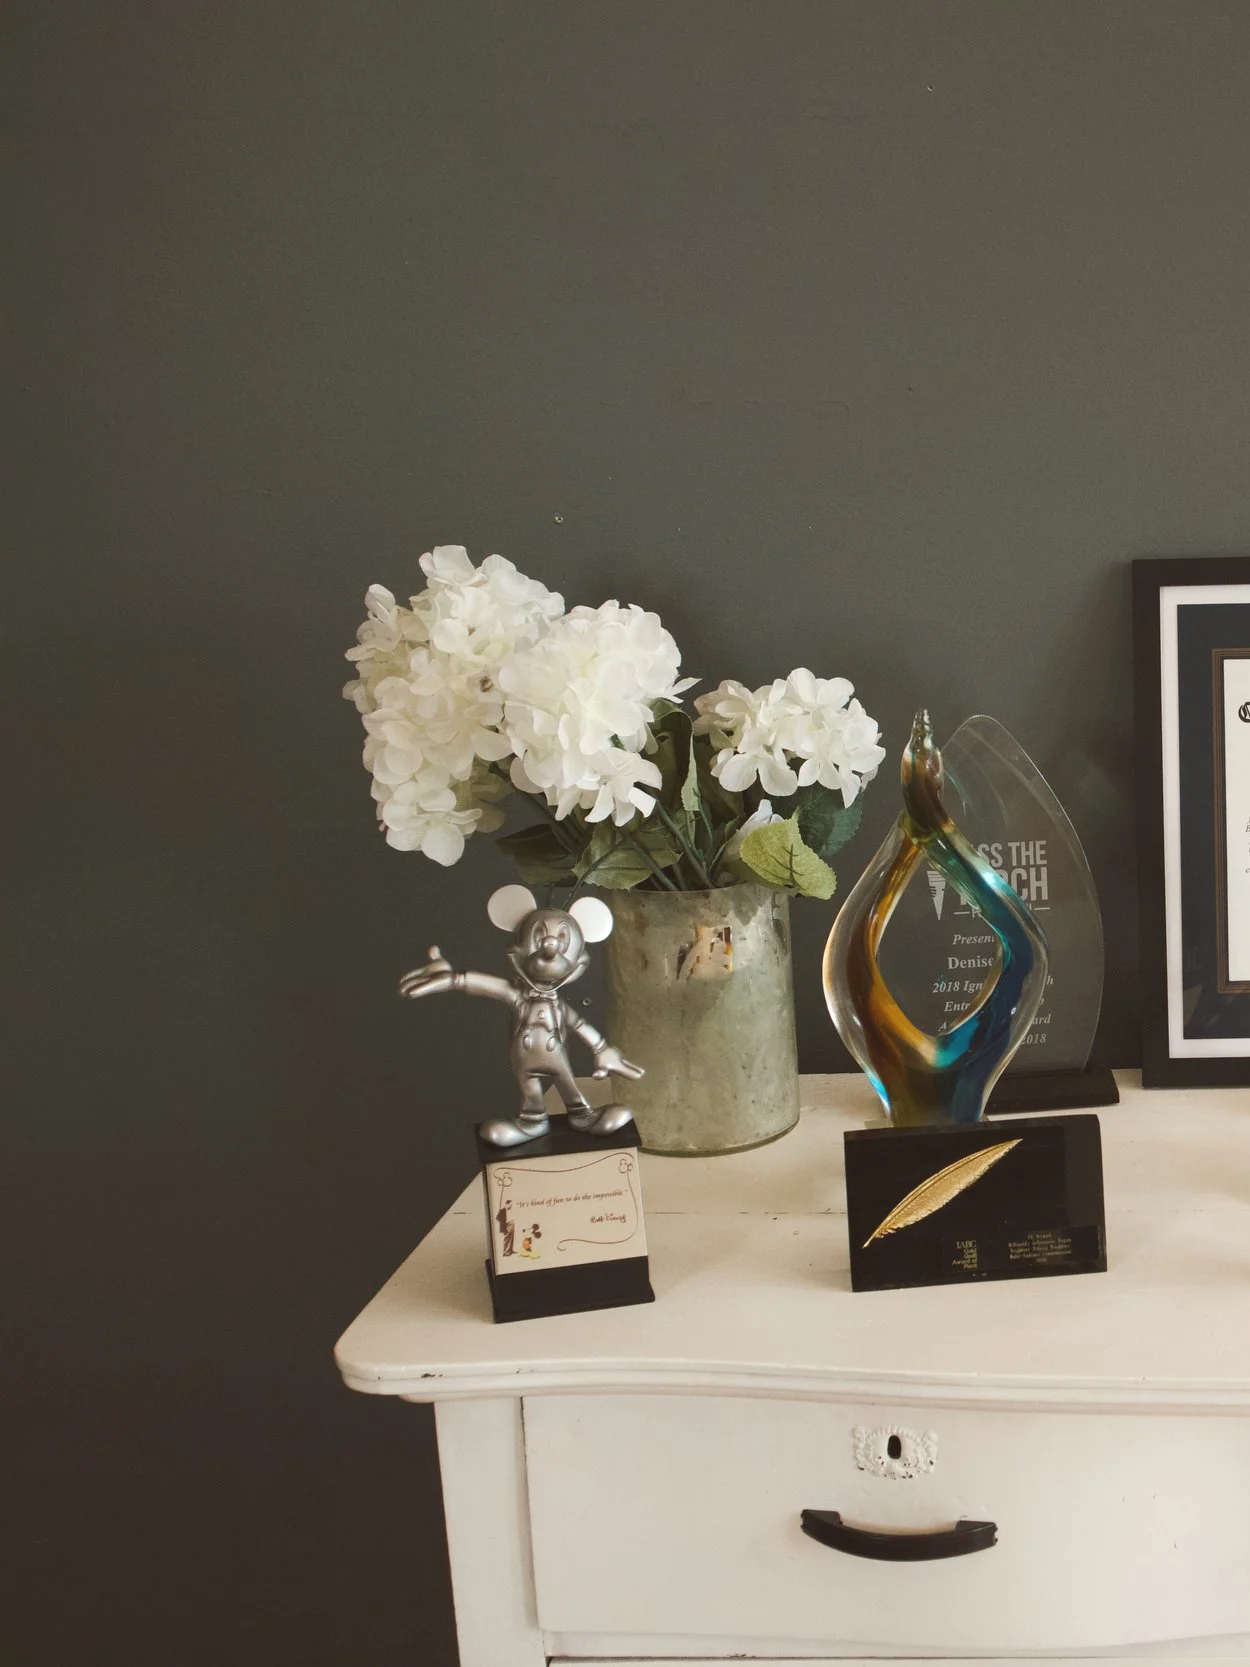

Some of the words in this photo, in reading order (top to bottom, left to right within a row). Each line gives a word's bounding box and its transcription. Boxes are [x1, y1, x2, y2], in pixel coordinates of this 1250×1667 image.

[1008, 840, 1048, 867] THE
[932, 981, 960, 993] 2018
[545, 1199, 552, 1207] of
[552, 1198, 564, 1207] fun
[573, 1194, 581, 1202] do
